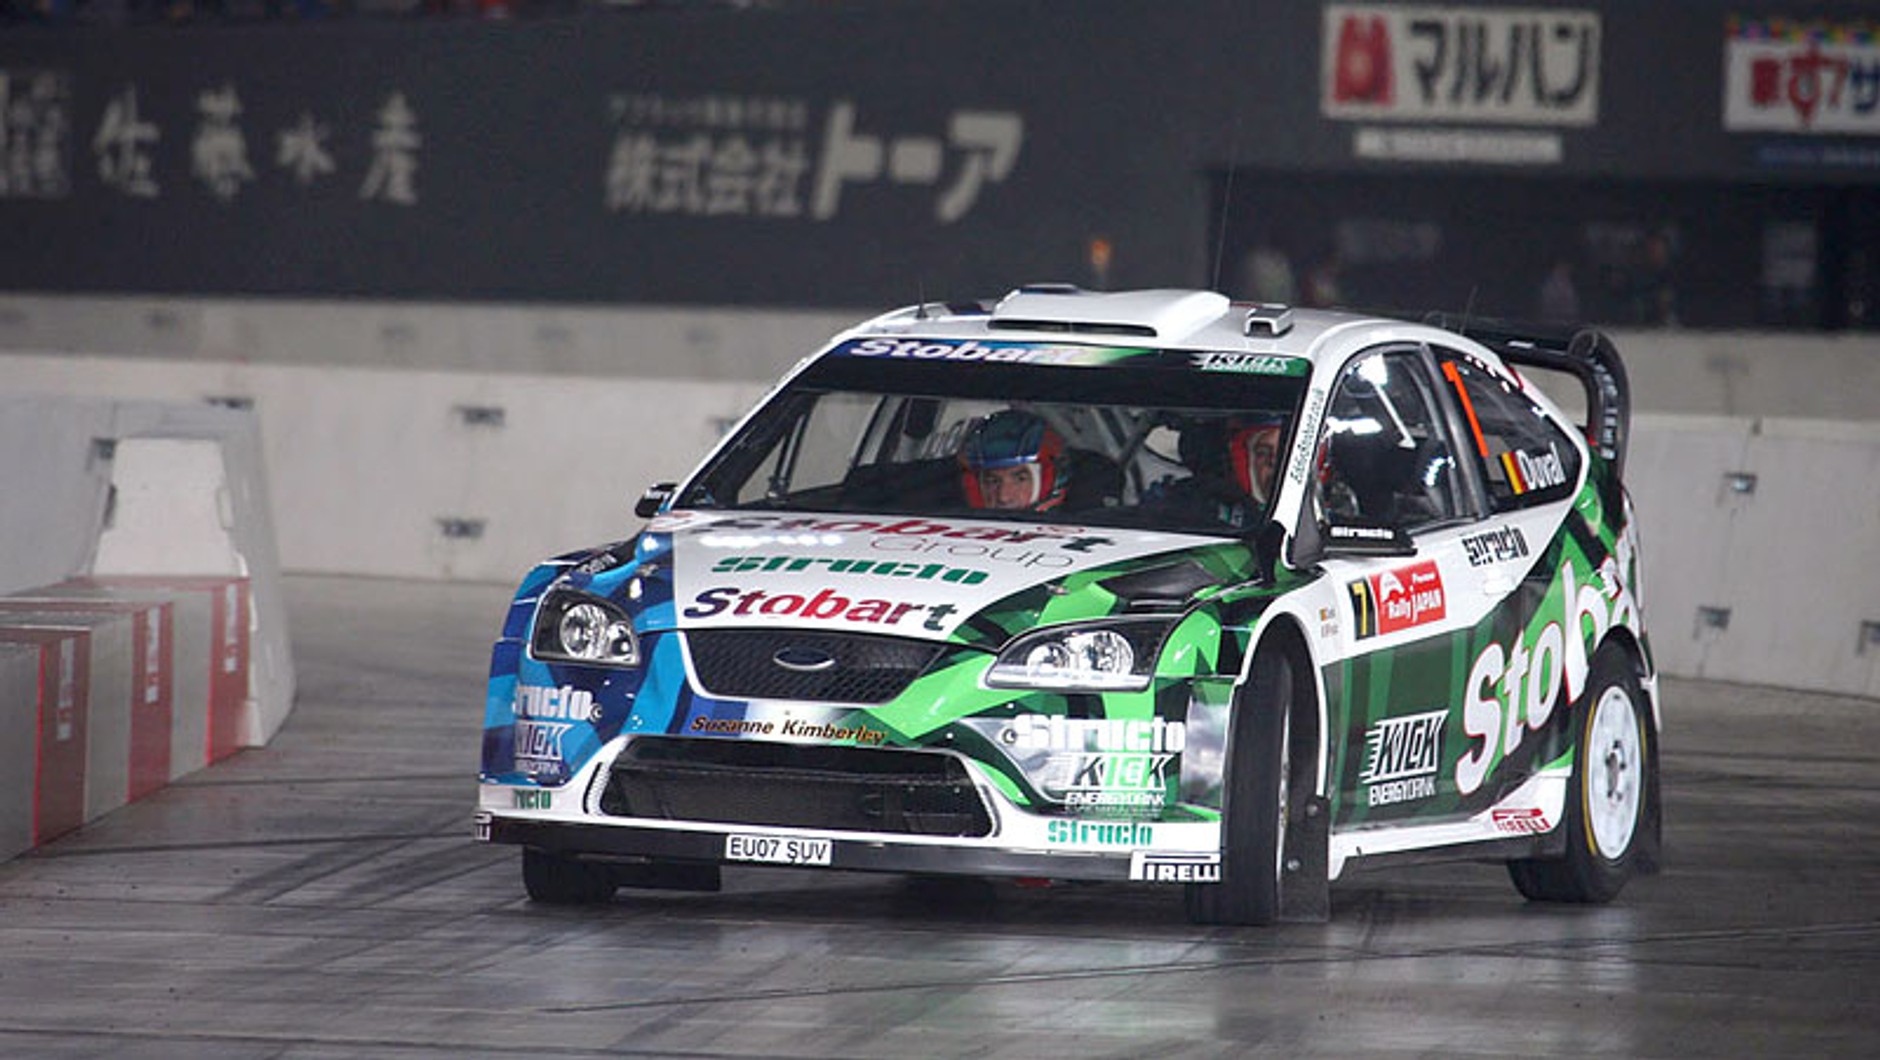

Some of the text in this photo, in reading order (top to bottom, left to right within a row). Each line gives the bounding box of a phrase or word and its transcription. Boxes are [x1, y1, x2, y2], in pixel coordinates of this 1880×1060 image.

[1408, 20, 1594, 106] マルハン
[850, 338, 1085, 364] Stobart
[1516, 440, 1566, 491] Duval
[692, 517, 1116, 555] Stobart
[870, 535, 1074, 568] Group
[683, 587, 958, 632] Stobart
[1352, 582, 1367, 636] 7
[691, 716, 887, 745] Suzanne Kimberley
[731, 837, 779, 858] EU07
[1049, 820, 1153, 845] Structo
